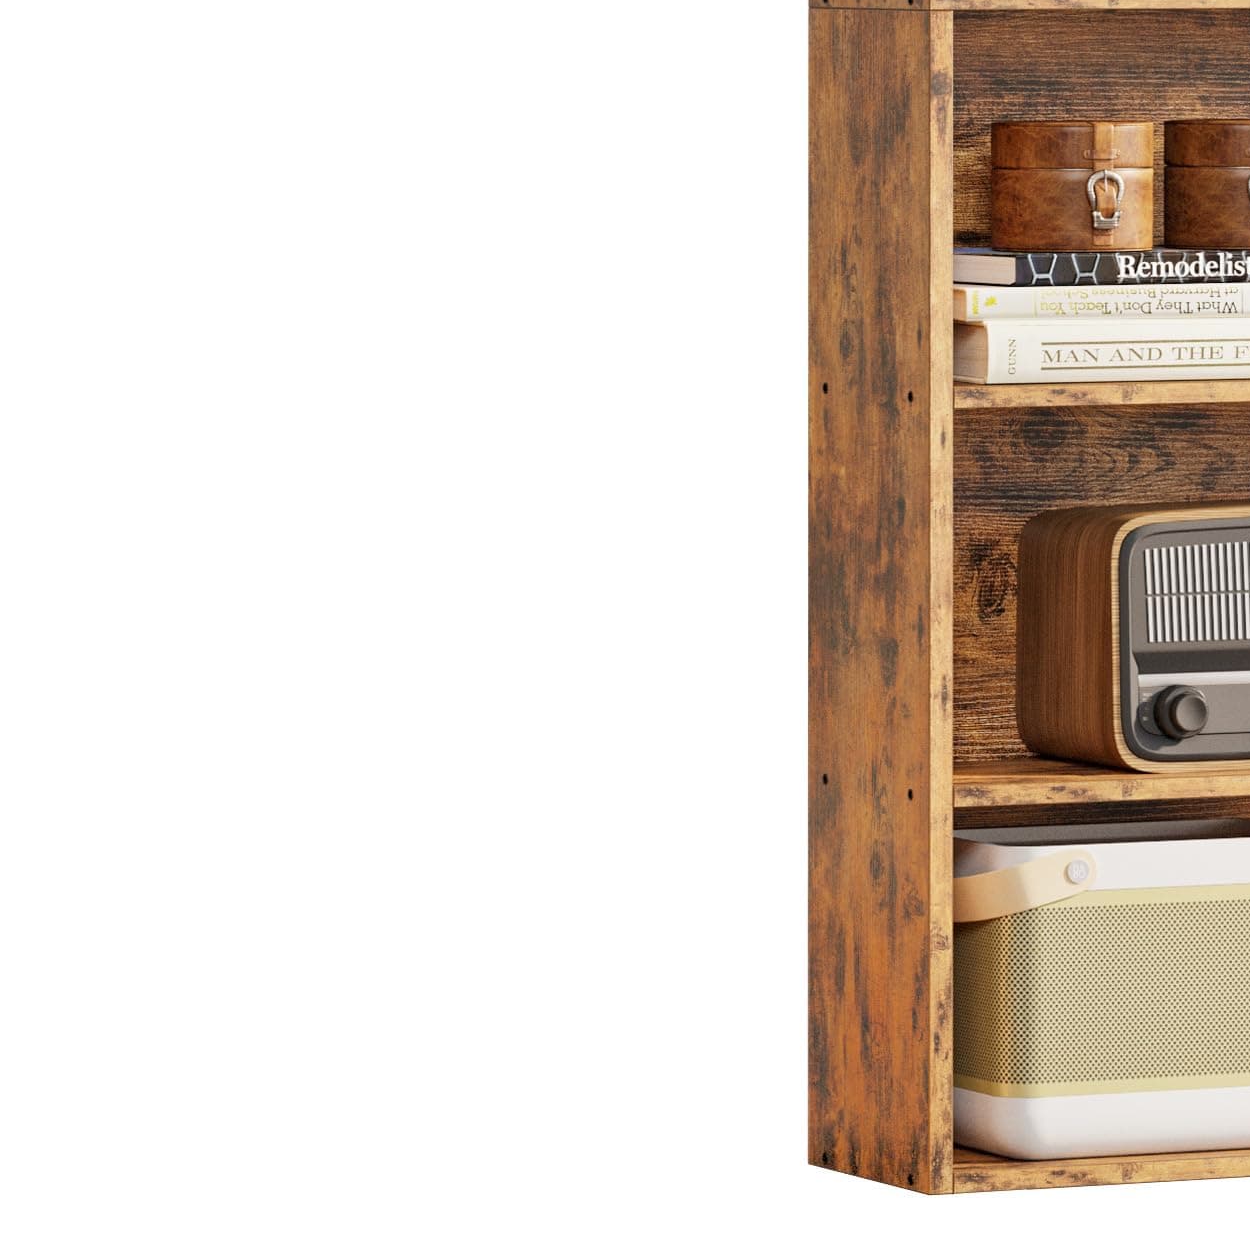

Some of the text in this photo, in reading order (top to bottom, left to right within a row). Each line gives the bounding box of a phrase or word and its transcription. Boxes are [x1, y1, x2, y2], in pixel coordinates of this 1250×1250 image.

[1040, 300, 1238, 316] What They Don't Teach You
[1008, 338, 1017, 375] GUNN
[1041, 349, 1100, 364] MAN
[1109, 348, 1162, 362] AND
[1171, 346, 1224, 361] THE
